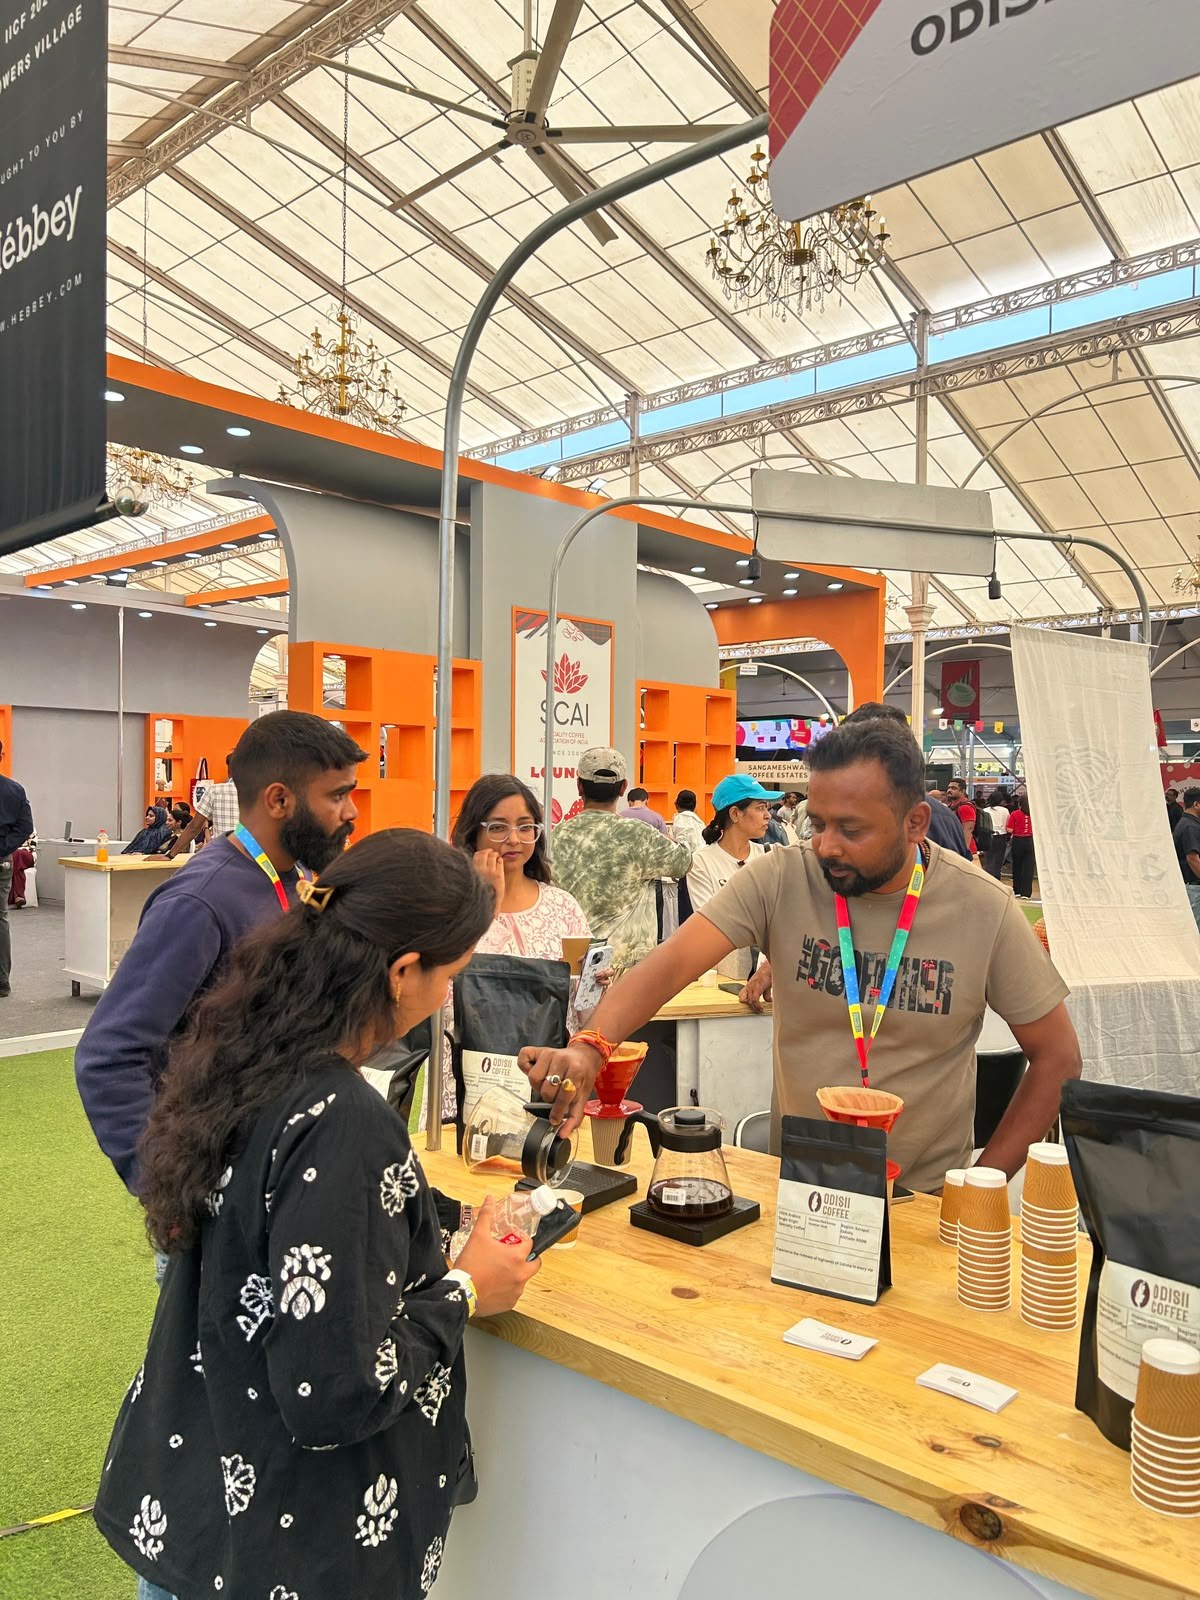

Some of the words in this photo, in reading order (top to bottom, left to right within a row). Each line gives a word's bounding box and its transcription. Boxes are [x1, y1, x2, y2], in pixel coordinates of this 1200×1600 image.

[5, 12, 26, 44] IICF
[34, 4, 82, 59] VILLAGE
[910, 0, 1056, 56] ODI
[29, 144, 40, 162] TO
[45, 124, 65, 148] YOU
[70, 109, 83, 129] BY
[0, 184, 83, 275] ébbey
[531, 766, 579, 779] LUN
[796, 934, 814, 982] THE
[807, 938, 956, 1015] GODFAHER
[491, 1067, 511, 1077] COFFEE
[822, 1205, 850, 1220] COFFEE
[823, 1193, 851, 1209] ODISII
[1153, 1284, 1190, 1308] ODISII
[1151, 1301, 1189, 1323] COFFEE
